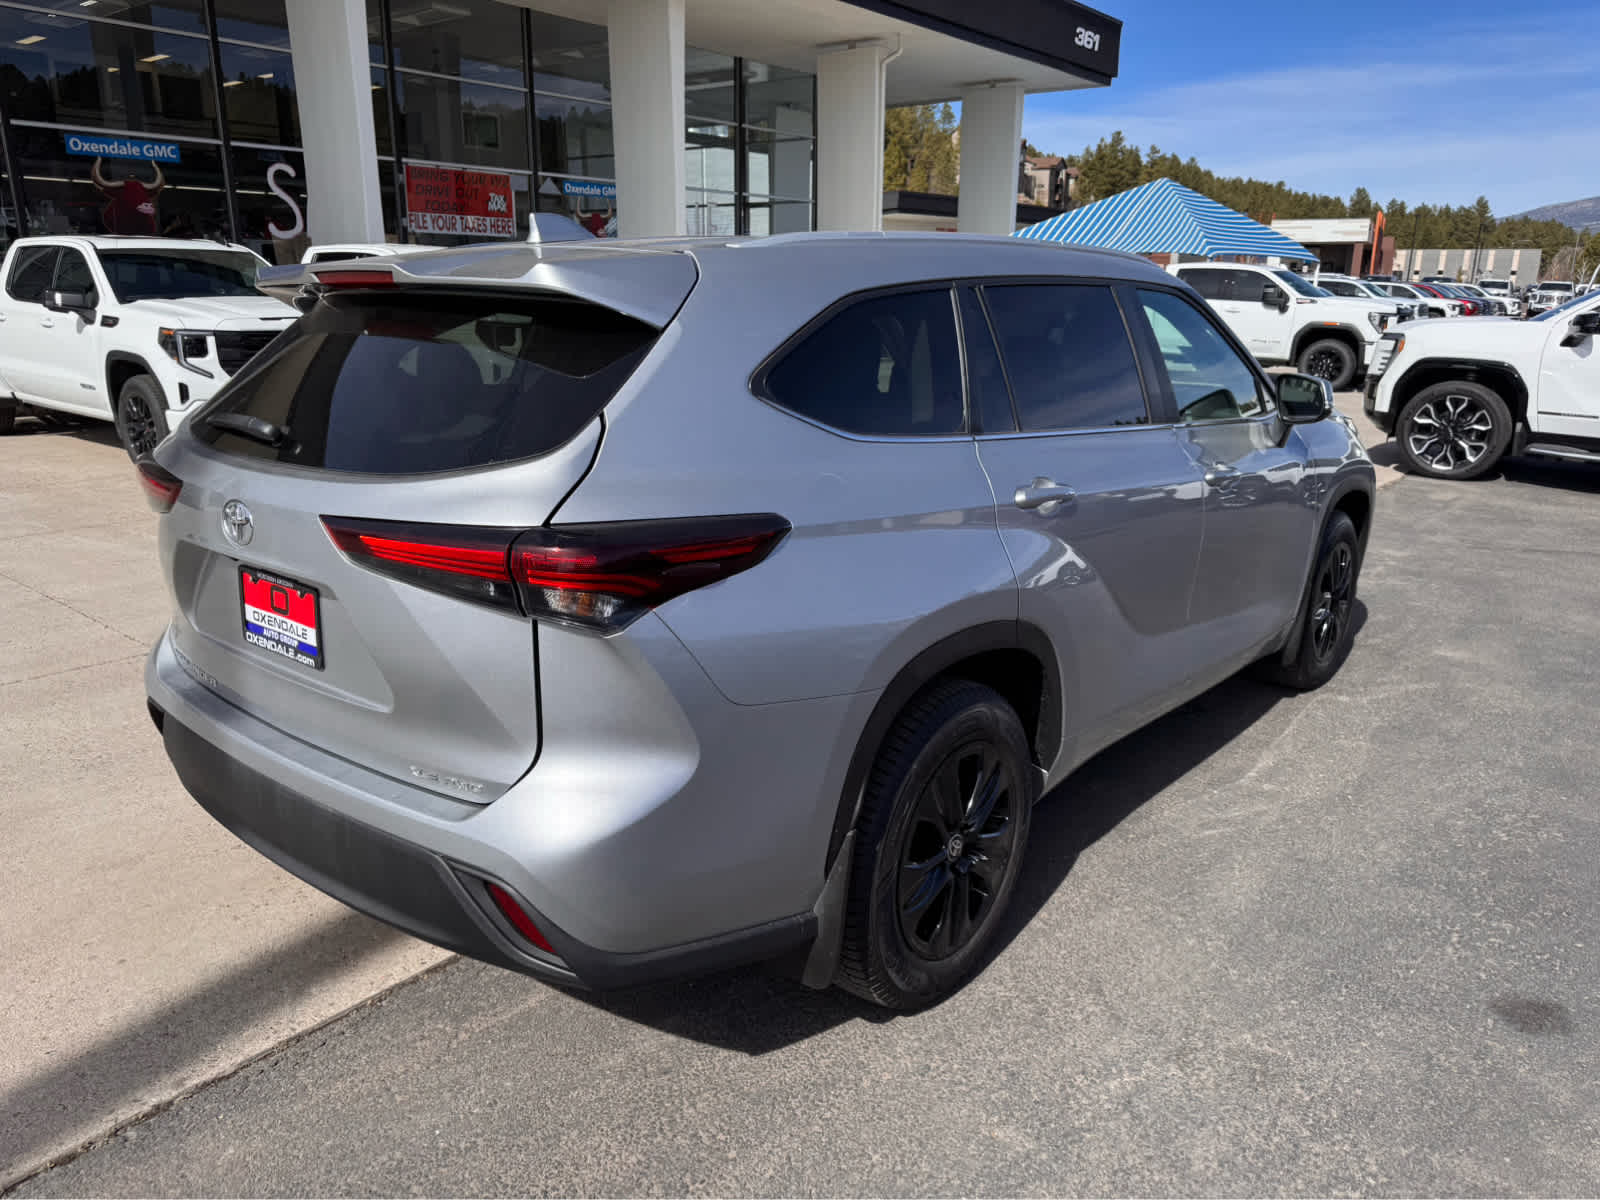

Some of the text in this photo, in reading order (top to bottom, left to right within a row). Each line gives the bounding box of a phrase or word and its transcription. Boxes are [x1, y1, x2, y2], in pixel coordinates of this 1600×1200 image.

[1074, 26, 1100, 51] 361
[69, 137, 177, 159] Oxendale GMC
[564, 183, 616, 196] Oxendale GM
[409, 214, 428, 230] FILE
[430, 215, 458, 232] YOUR
[460, 216, 488, 233] TAXES
[252, 610, 308, 640] OXENDALE
[263, 628, 298, 648] AUTO GROUP
[246, 632, 316, 668] OXENDALE.com
